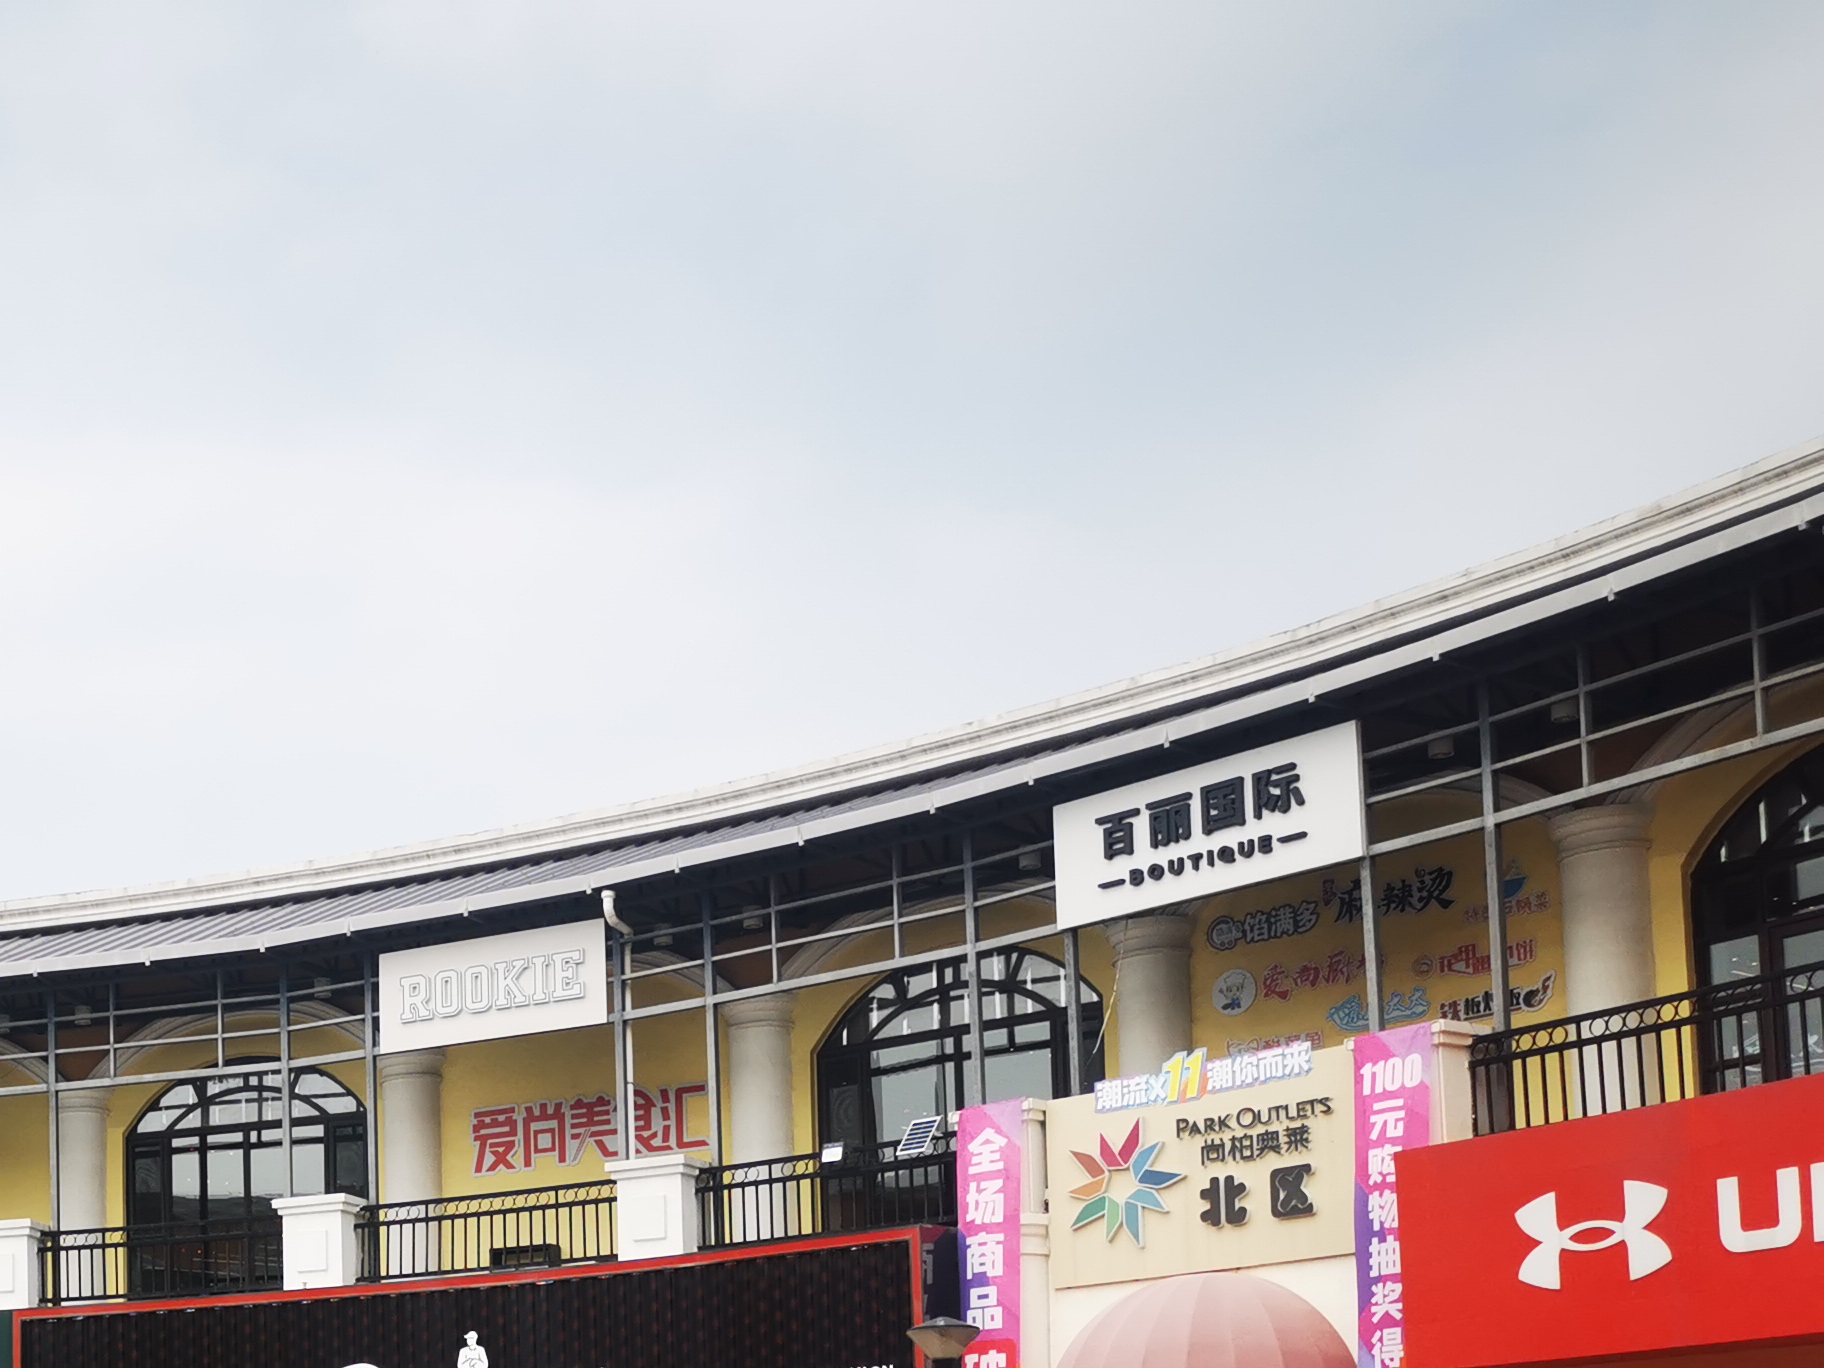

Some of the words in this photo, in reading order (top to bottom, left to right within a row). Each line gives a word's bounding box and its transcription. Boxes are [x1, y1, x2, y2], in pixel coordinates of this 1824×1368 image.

[1095, 762, 1306, 861] 百丽国际
[1129, 834, 1273, 886] BOUTIQUE
[400, 948, 585, 1023] ROOKIE
[1262, 950, 1385, 1001] 爱尚厨
[471, 1083, 712, 1174] 爱尚美食汇
[1176, 1114, 1232, 1138] PARK
[1236, 1097, 1334, 1129] OUTLETS
[1201, 1123, 1312, 1168] 尚柏奥莱
[1200, 1163, 1316, 1227] 北区
[1716, 1162, 1824, 1252] U
